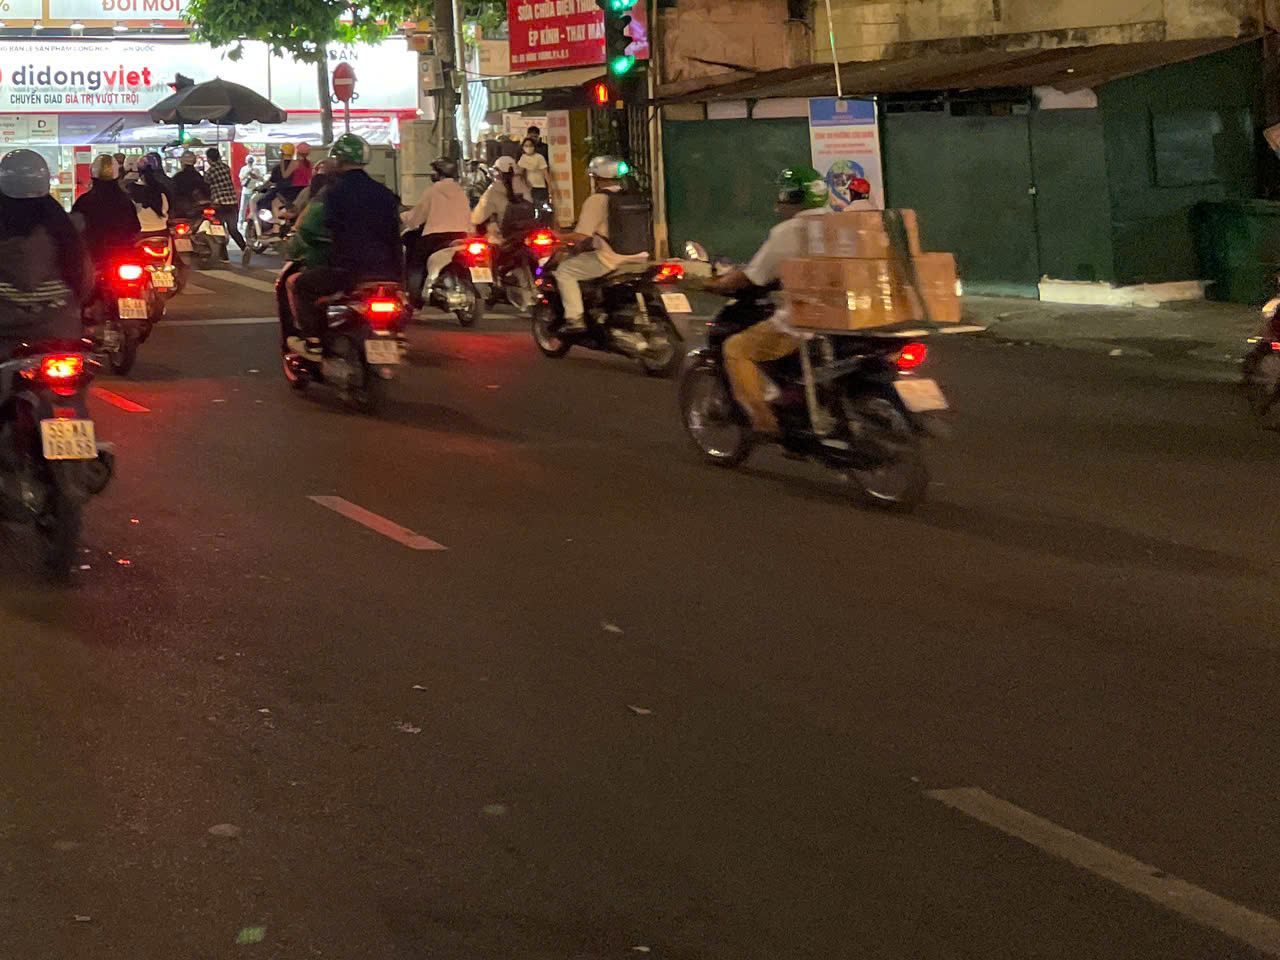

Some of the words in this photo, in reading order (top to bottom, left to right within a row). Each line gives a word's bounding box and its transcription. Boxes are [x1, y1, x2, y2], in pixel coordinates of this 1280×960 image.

[12, 64, 151, 92] didongviet
[10, 90, 40, 105] CHUYỂN
[44, 94, 63, 105] GIAO
[65, 92, 78, 105] GIÁ
[81, 94, 94, 107] TRỊ
